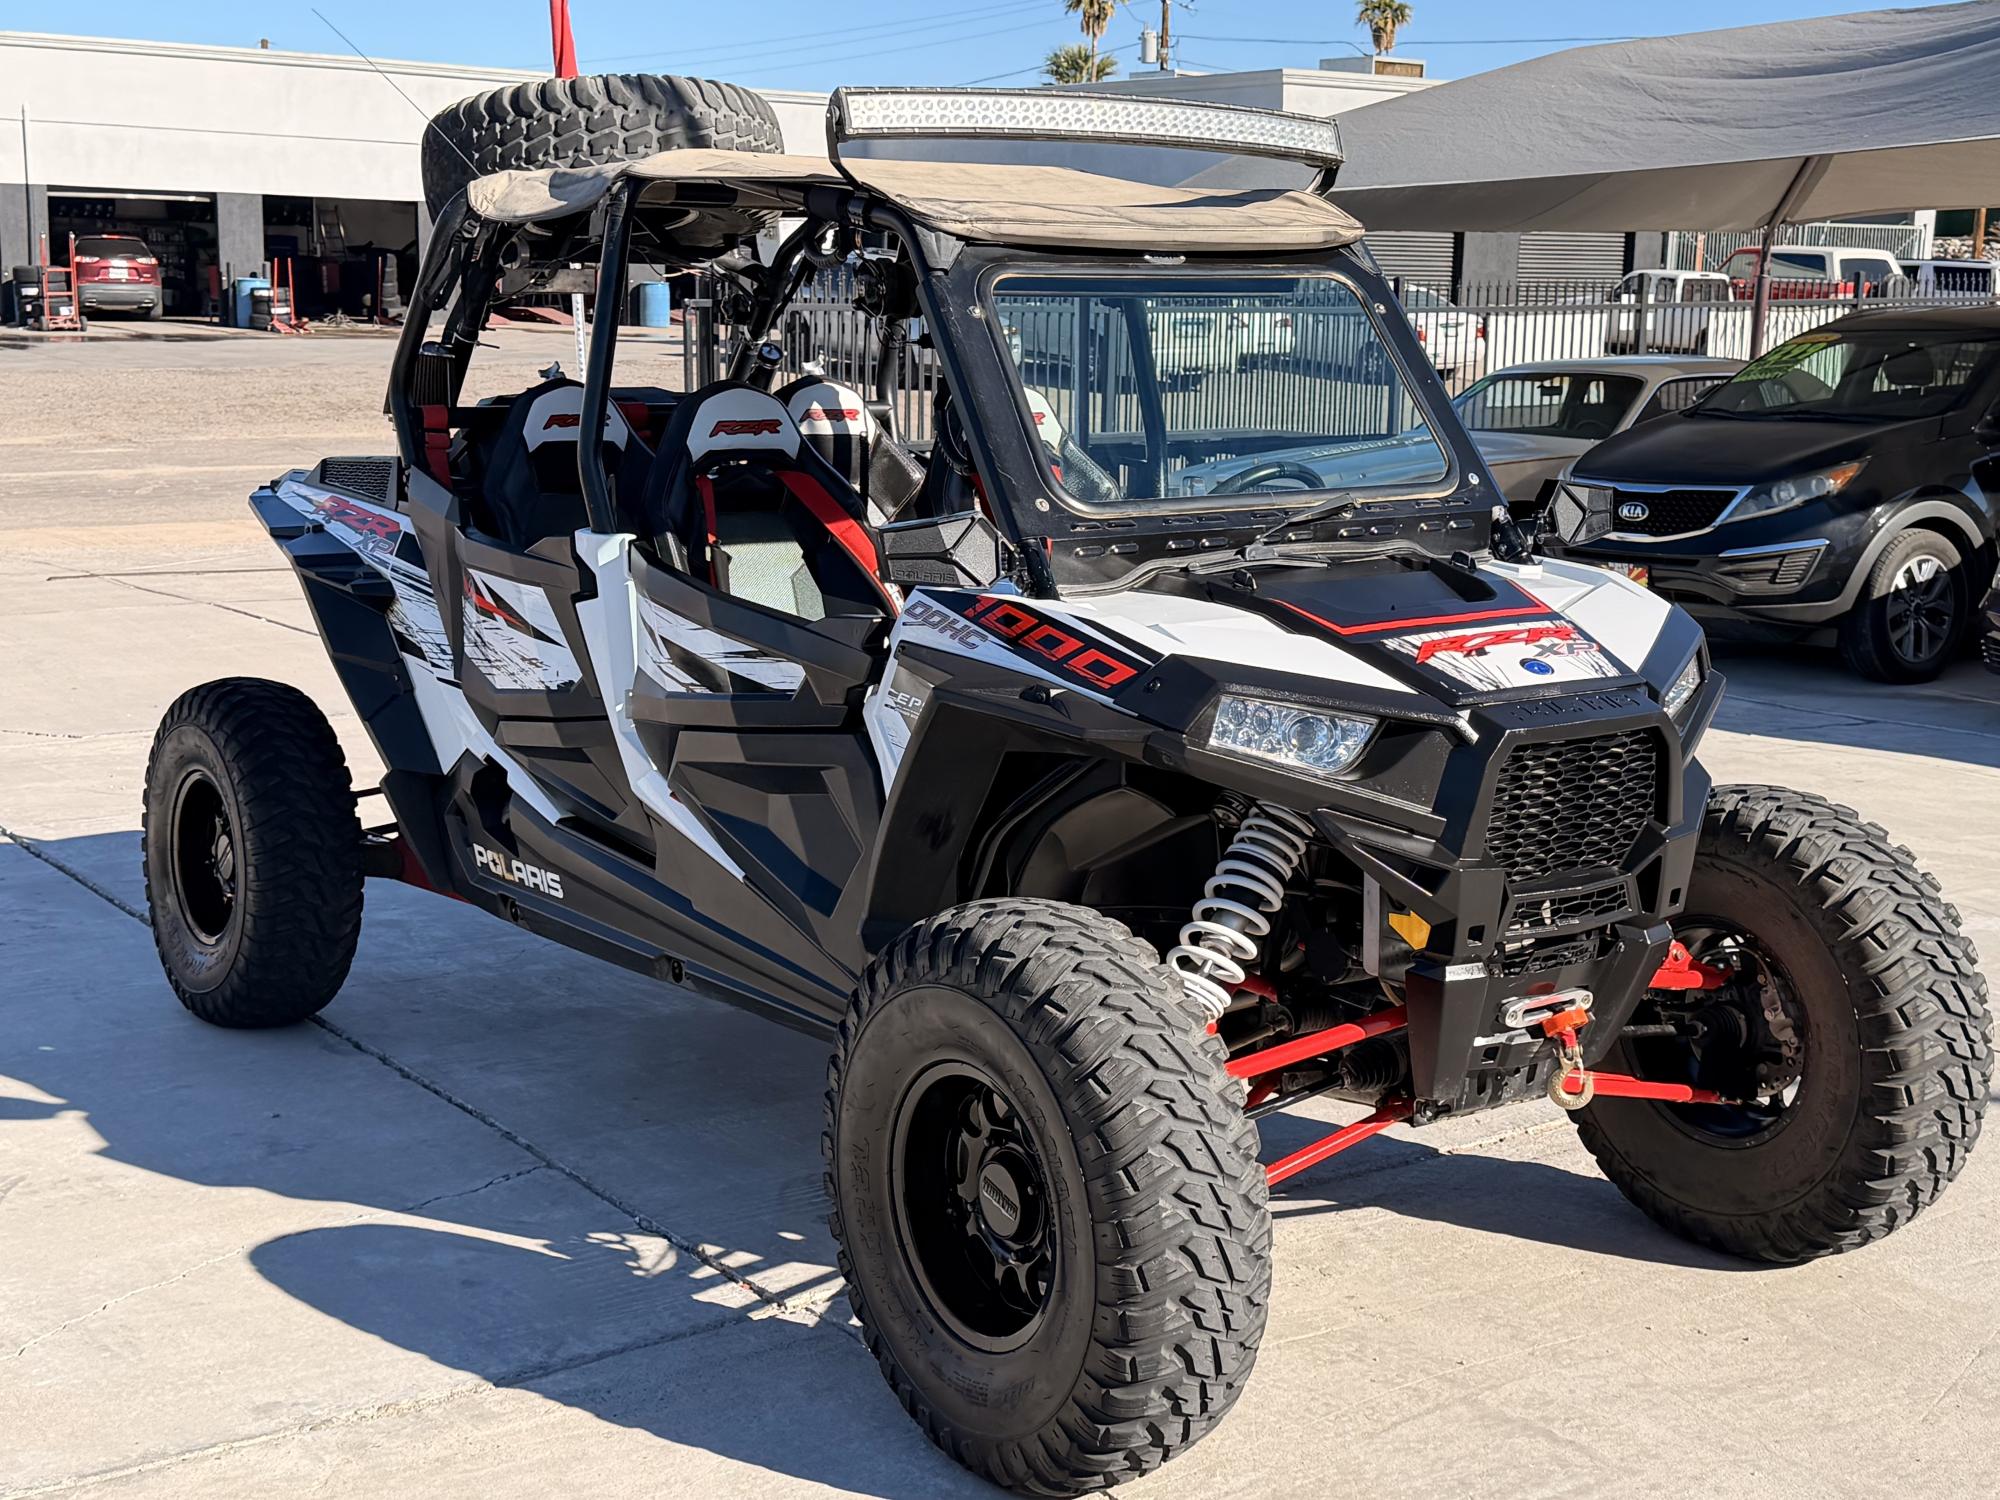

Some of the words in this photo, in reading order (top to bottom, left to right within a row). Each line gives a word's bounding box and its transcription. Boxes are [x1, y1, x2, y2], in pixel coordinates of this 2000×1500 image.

[709, 419, 783, 439] RZR
[310, 494, 401, 538] RZR
[353, 530, 396, 556] XP
[903, 600, 990, 649] DOHC
[963, 595, 1139, 690] 1000
[1416, 626, 1578, 665] RZR
[1532, 640, 1600, 658] XP
[472, 842, 565, 900] POLARIS
